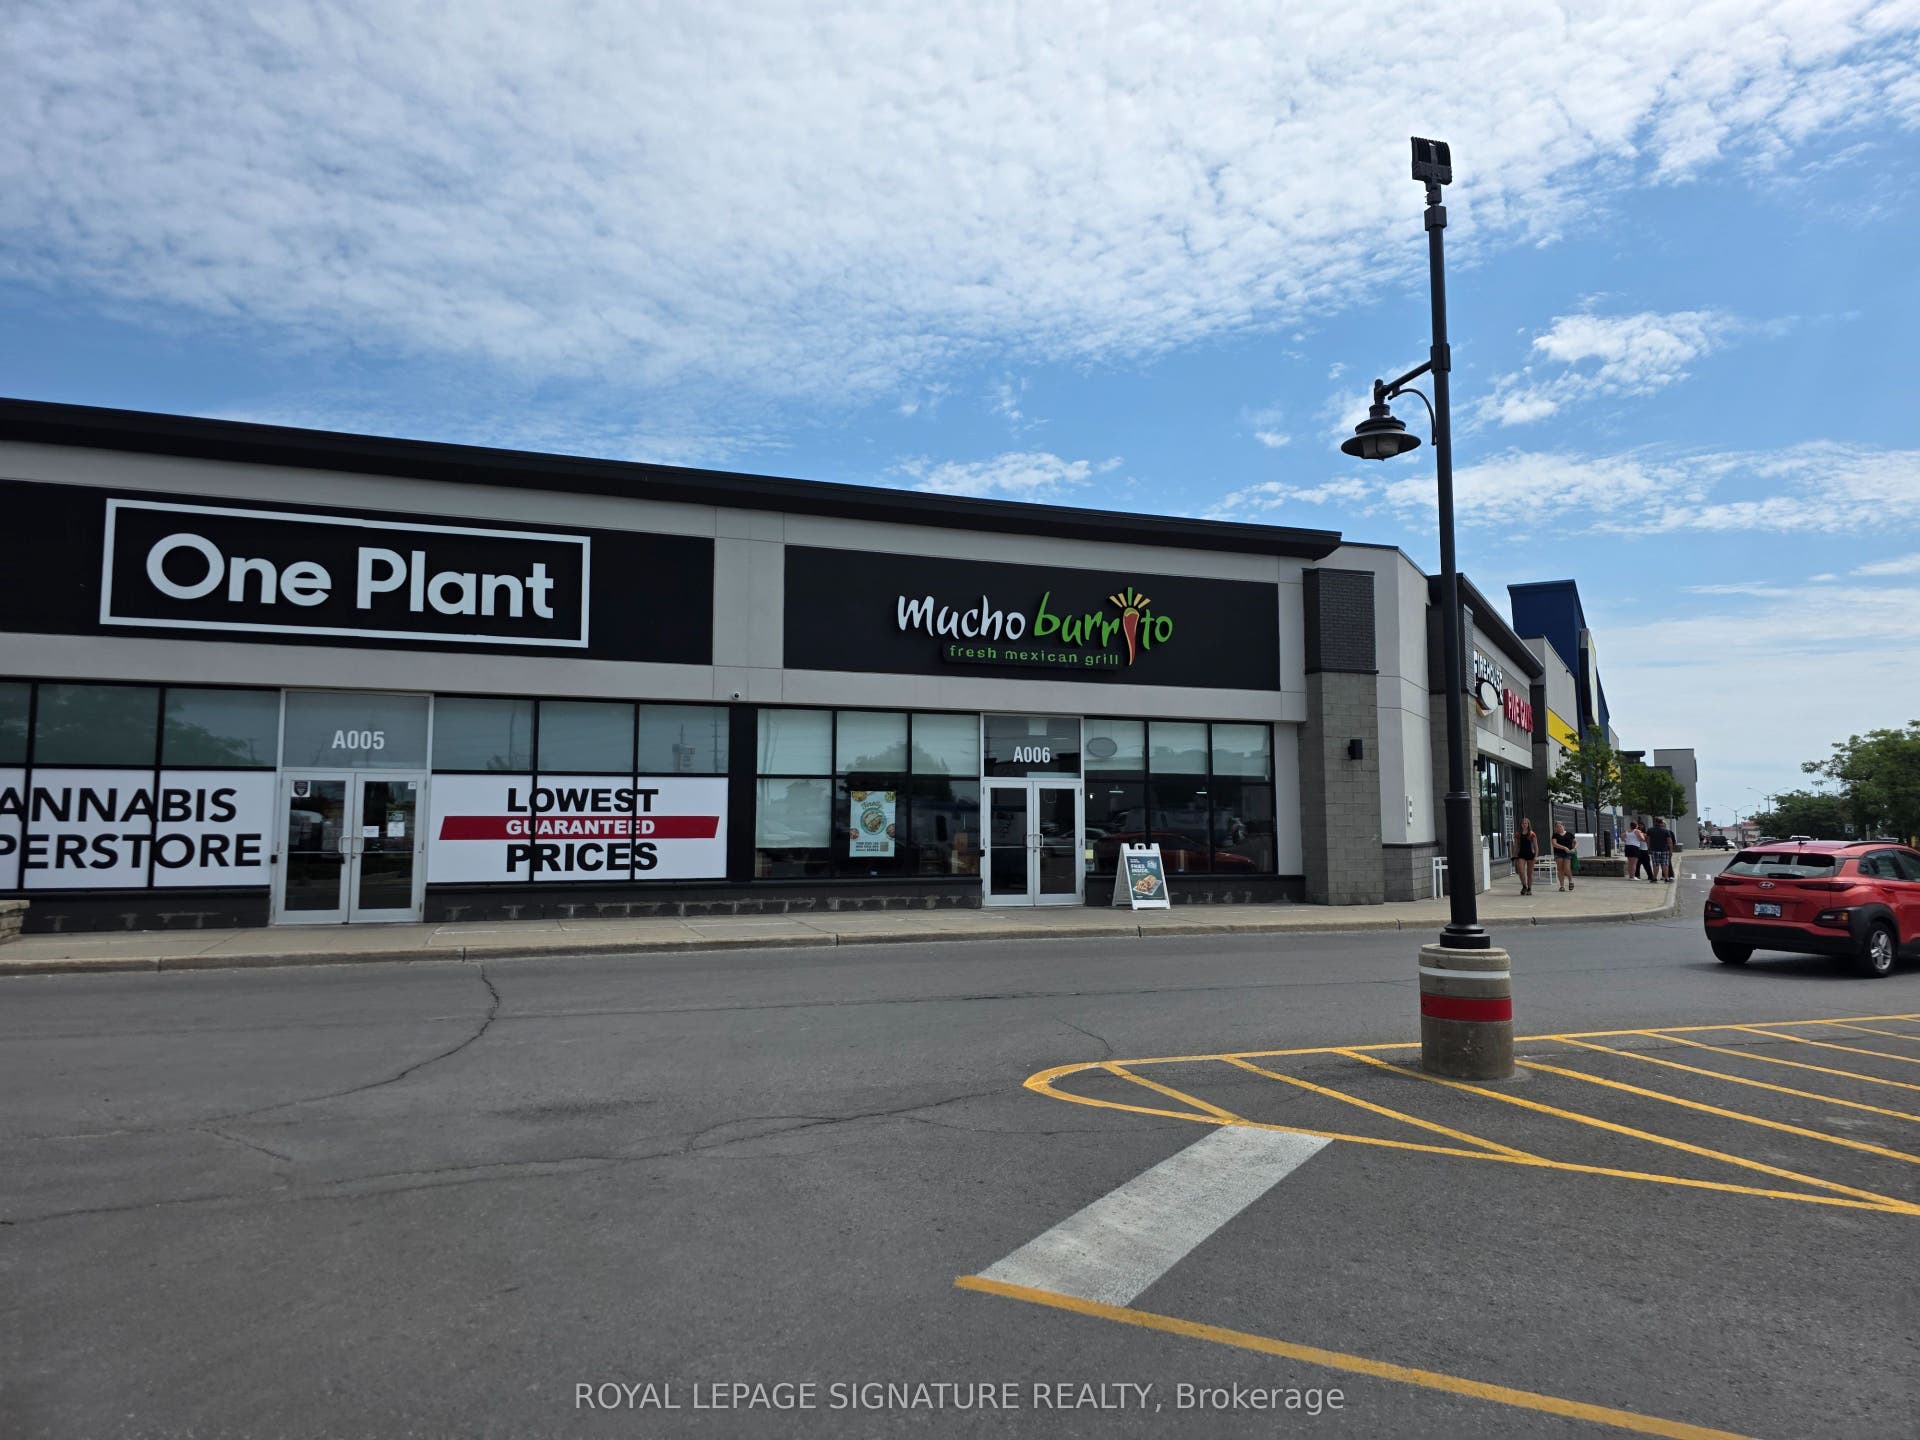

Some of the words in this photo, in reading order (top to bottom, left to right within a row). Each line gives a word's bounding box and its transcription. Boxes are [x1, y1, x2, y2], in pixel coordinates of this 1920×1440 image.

[146, 532, 332, 607] One
[356, 546, 554, 619] Plant
[1034, 587, 1174, 666] burrito
[949, 645, 997, 659] fresh
[1004, 648, 1078, 664] mexican
[1084, 653, 1119, 666] grill
[331, 729, 385, 750] A005
[1013, 746, 1051, 763] A006
[507, 787, 659, 813] LOWEST
[505, 819, 655, 835] GUARANTEED
[506, 842, 658, 873] PRICES
